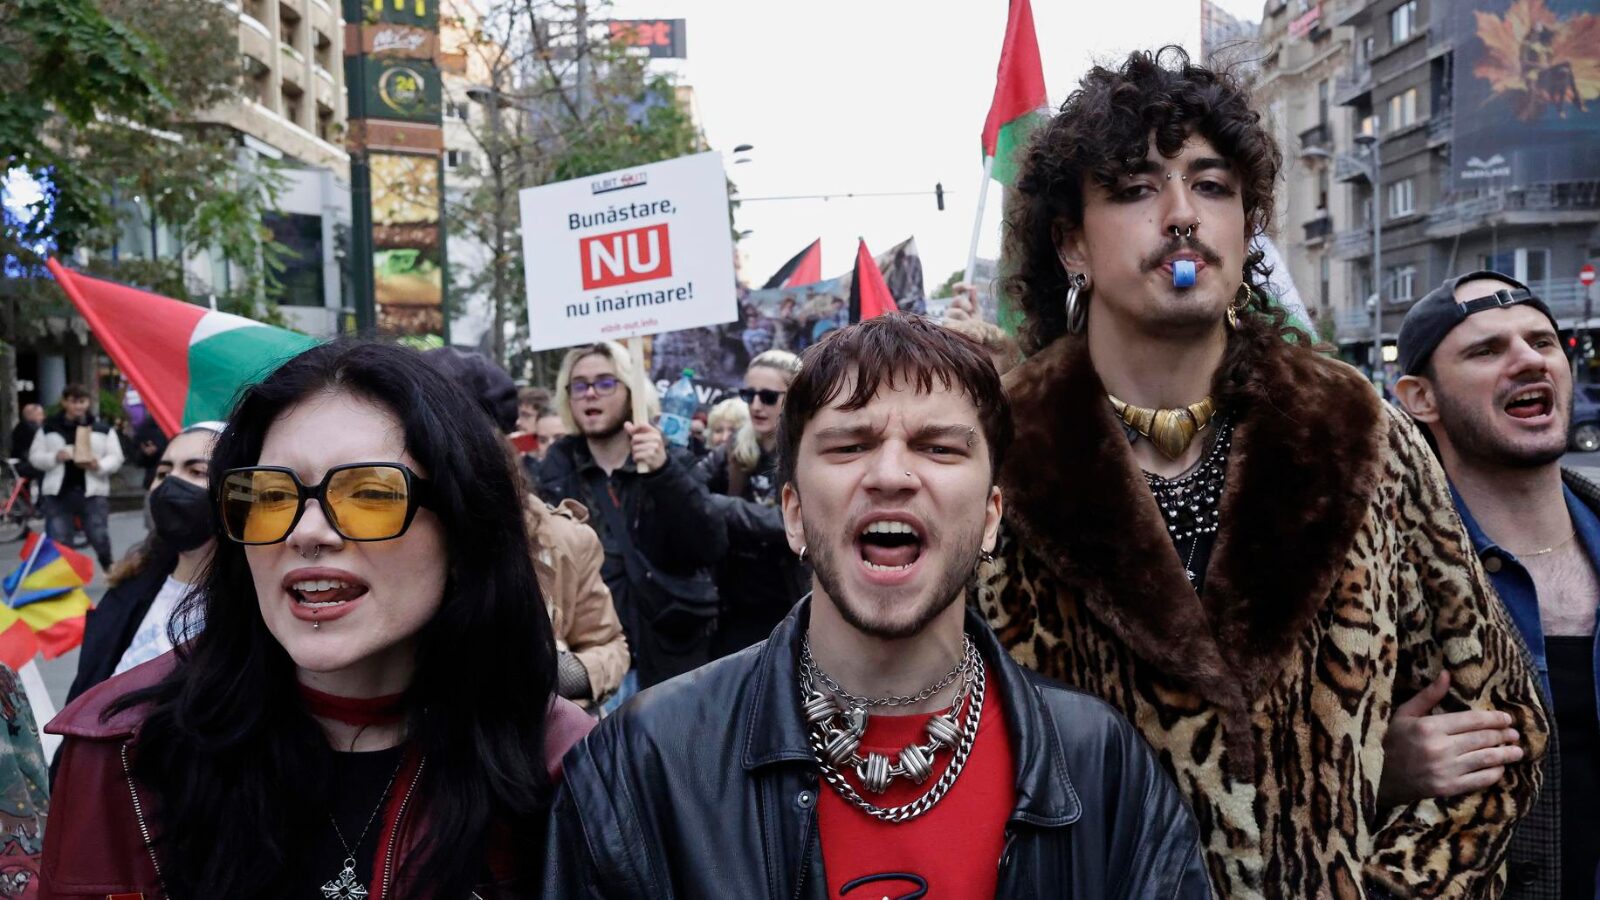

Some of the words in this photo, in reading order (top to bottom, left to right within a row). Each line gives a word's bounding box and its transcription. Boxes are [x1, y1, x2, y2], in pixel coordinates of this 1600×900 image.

[395, 75, 416, 90] 24
[591, 178, 617, 191] ELBIT
[568, 199, 677, 230] Bunăstare,
[588, 229, 661, 281] NU
[566, 301, 590, 318] nu
[595, 282, 693, 314] înarmare!
